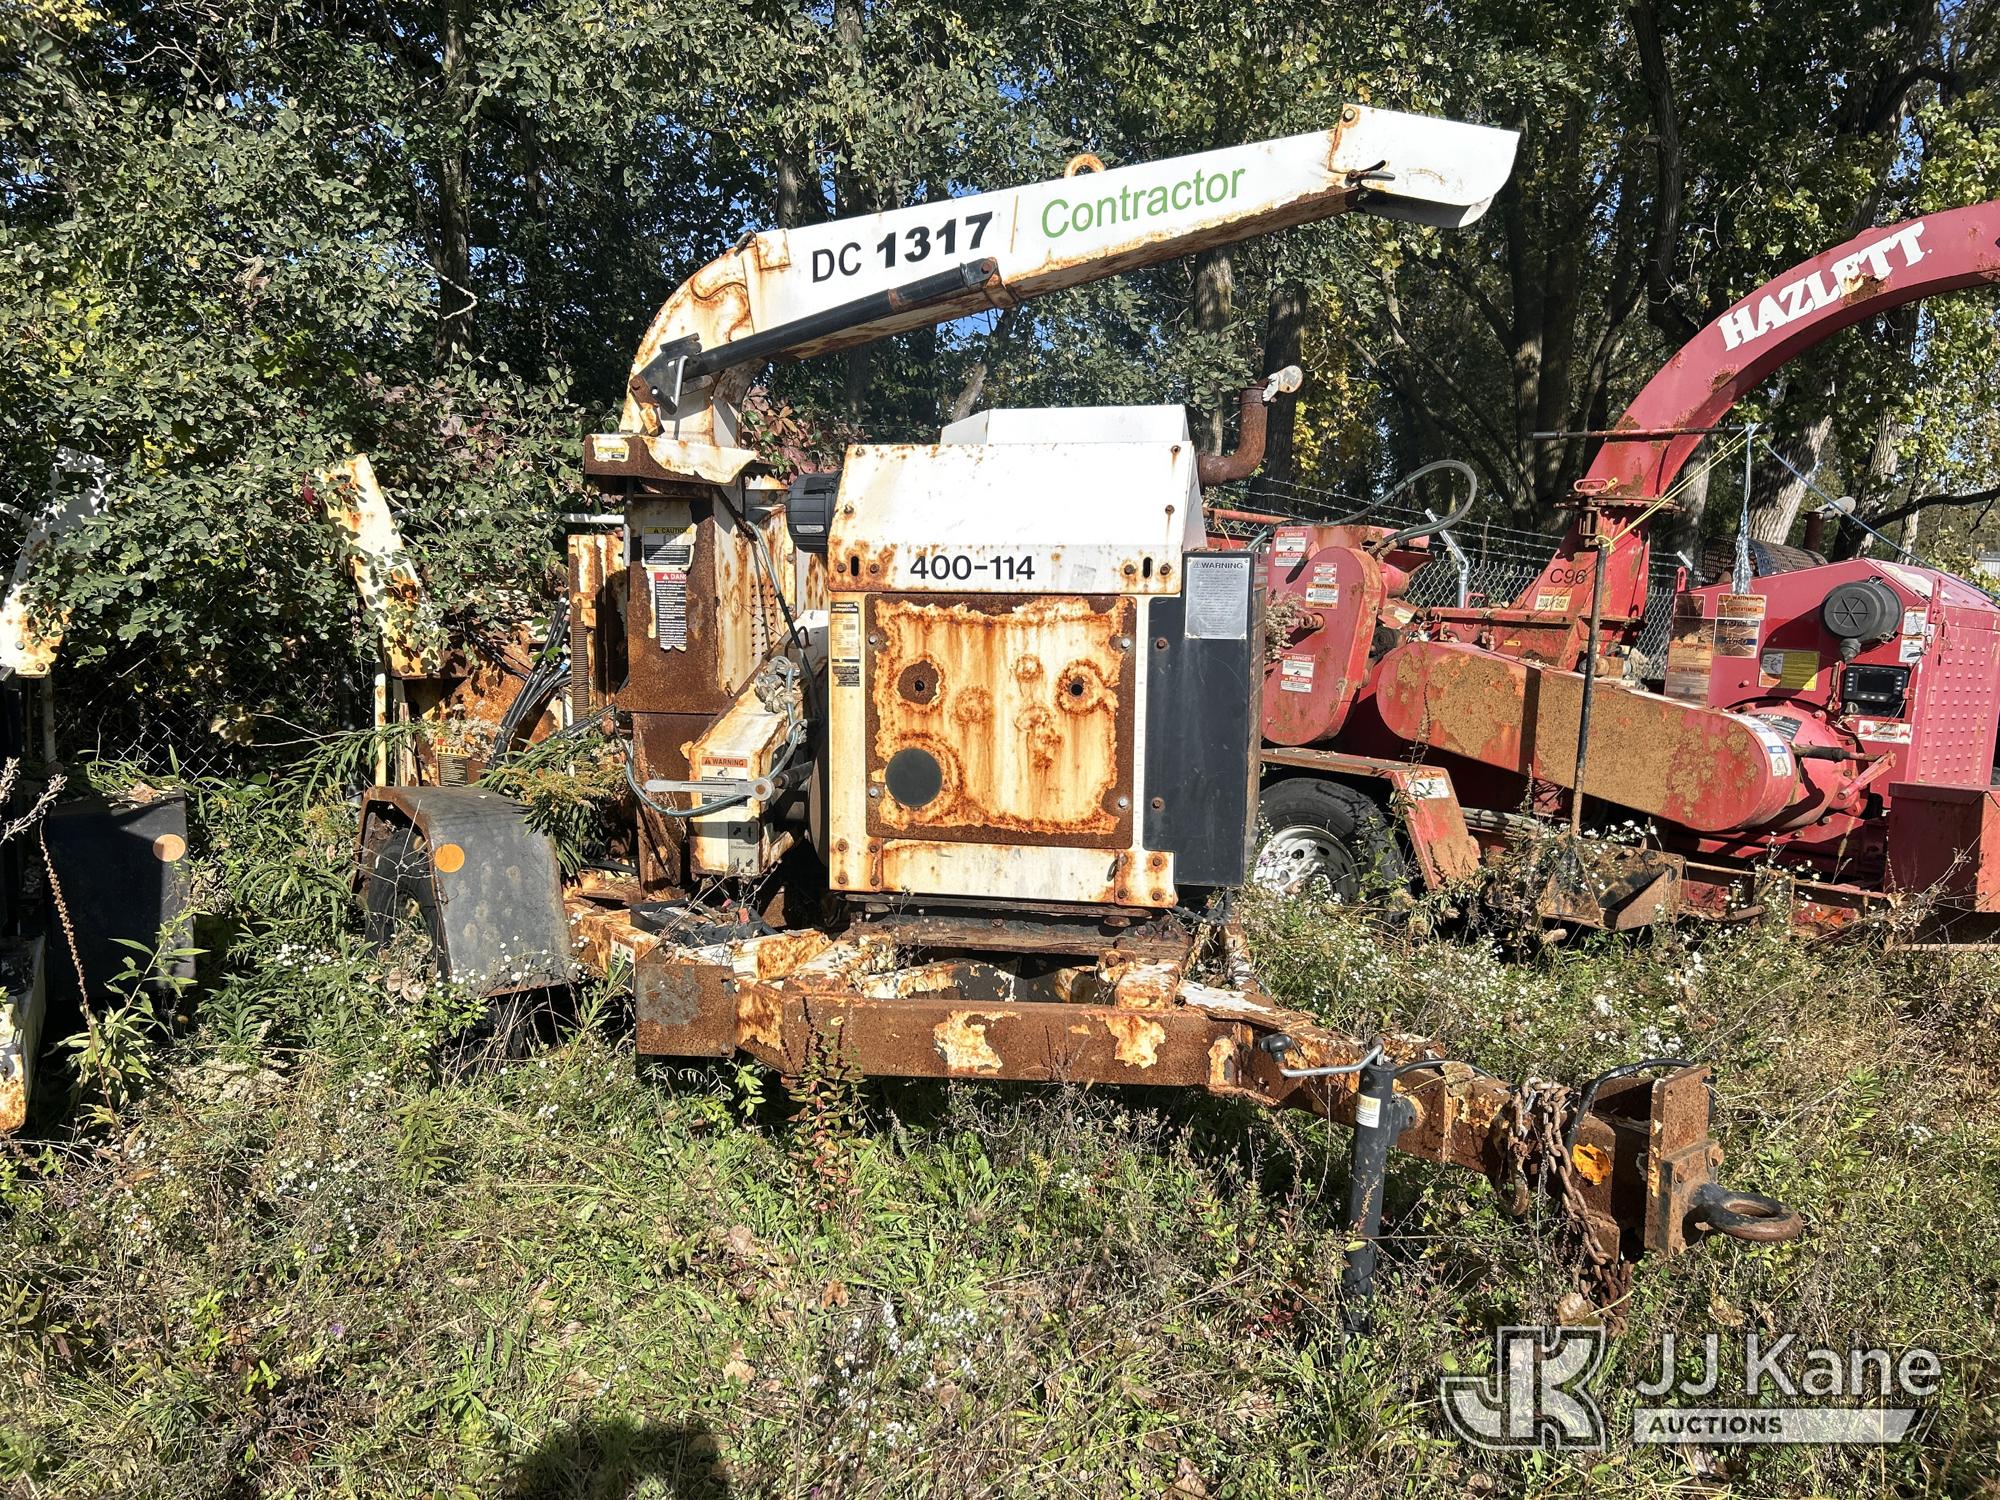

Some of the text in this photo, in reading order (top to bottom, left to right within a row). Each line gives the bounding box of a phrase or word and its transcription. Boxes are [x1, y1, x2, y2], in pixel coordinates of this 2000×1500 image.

[1041, 168, 1245, 239] Contractor
[812, 211, 993, 283] DC 1317
[910, 555, 1036, 580] 400-114
[1550, 568, 1587, 584] C96
